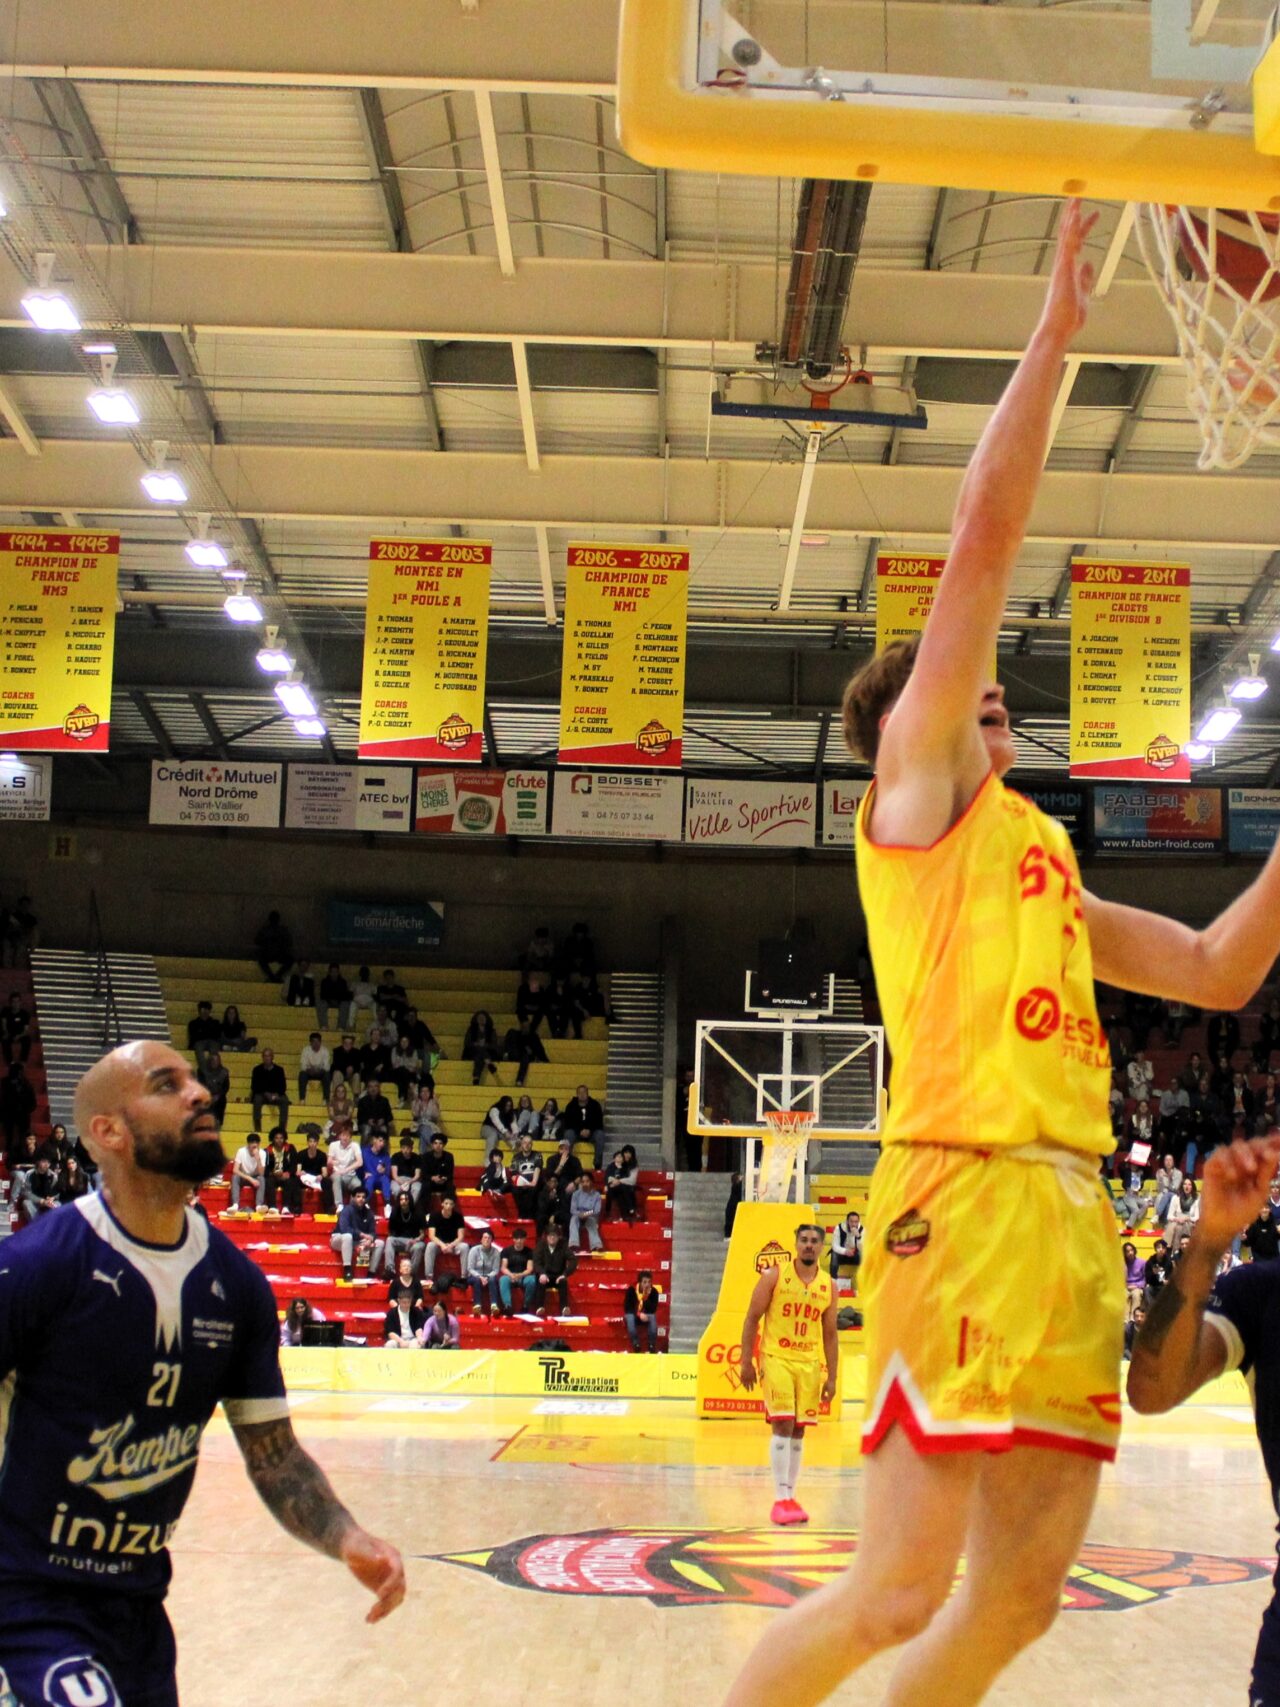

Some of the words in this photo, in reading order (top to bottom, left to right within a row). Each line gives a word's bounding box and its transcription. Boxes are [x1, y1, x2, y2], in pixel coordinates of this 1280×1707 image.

[9, 534, 48, 550] 1994
[69, 536, 109, 552] 1995
[377, 544, 420, 560] 2002
[441, 546, 484, 562] 2003
[15, 556, 78, 568] CHAMPION
[82, 558, 98, 568] DE
[574, 550, 618, 567] 2006
[640, 552, 683, 569] 2007
[447, 568, 463, 578] EN
[887, 560, 930, 576] 2009
[32, 570, 80, 582] FRANCE
[585, 571, 648, 584] CHAMPION
[652, 574, 668, 585] DE
[1085, 567, 1122, 582] 2010
[1143, 568, 1176, 584] 2011
[42, 585, 68, 596] NM3
[416, 580, 439, 591] NM1
[884, 584, 933, 594] CHAMPION
[601, 586, 650, 598] FRANCE
[1079, 591, 1127, 600] CHAMPION
[1130, 592, 1142, 601] DE
[1145, 593, 1181, 603] FRANCE
[411, 595, 450, 606] POULE
[453, 596, 461, 606] A
[613, 601, 637, 612] NM1
[1112, 604, 1148, 612] CADETS
[1109, 614, 1150, 624] DIVISION
[375, 700, 408, 708] COACHS
[574, 706, 607, 715] COACHS
[1084, 722, 1115, 730] COACHS
[440, 726, 471, 740] SVBD
[640, 732, 670, 747] SVBD
[157, 767, 204, 782] Crédit
[224, 769, 277, 784] Mutuel
[598, 776, 663, 786] BOISSET
[179, 786, 210, 798] Nord
[214, 787, 258, 799] Drôme
[360, 793, 389, 803] ATEC
[421, 788, 448, 799] MOINS
[695, 798, 734, 806] VALLIER
[1104, 793, 1179, 807] FABBRI
[180, 812, 191, 820] 04
[196, 812, 206, 820] 75
[208, 813, 220, 821] 03
[222, 813, 234, 821] 03
[597, 810, 606, 819] 04
[689, 812, 732, 841] Ville
[738, 794, 813, 833] Sportive
[1104, 807, 1152, 817] FROID
[1103, 838, 1214, 849] www.fabbri-froid.com
[782, 1302, 820, 1322] SVBD
[794, 1321, 807, 1336] 10
[146, 1362, 182, 1407] 21
